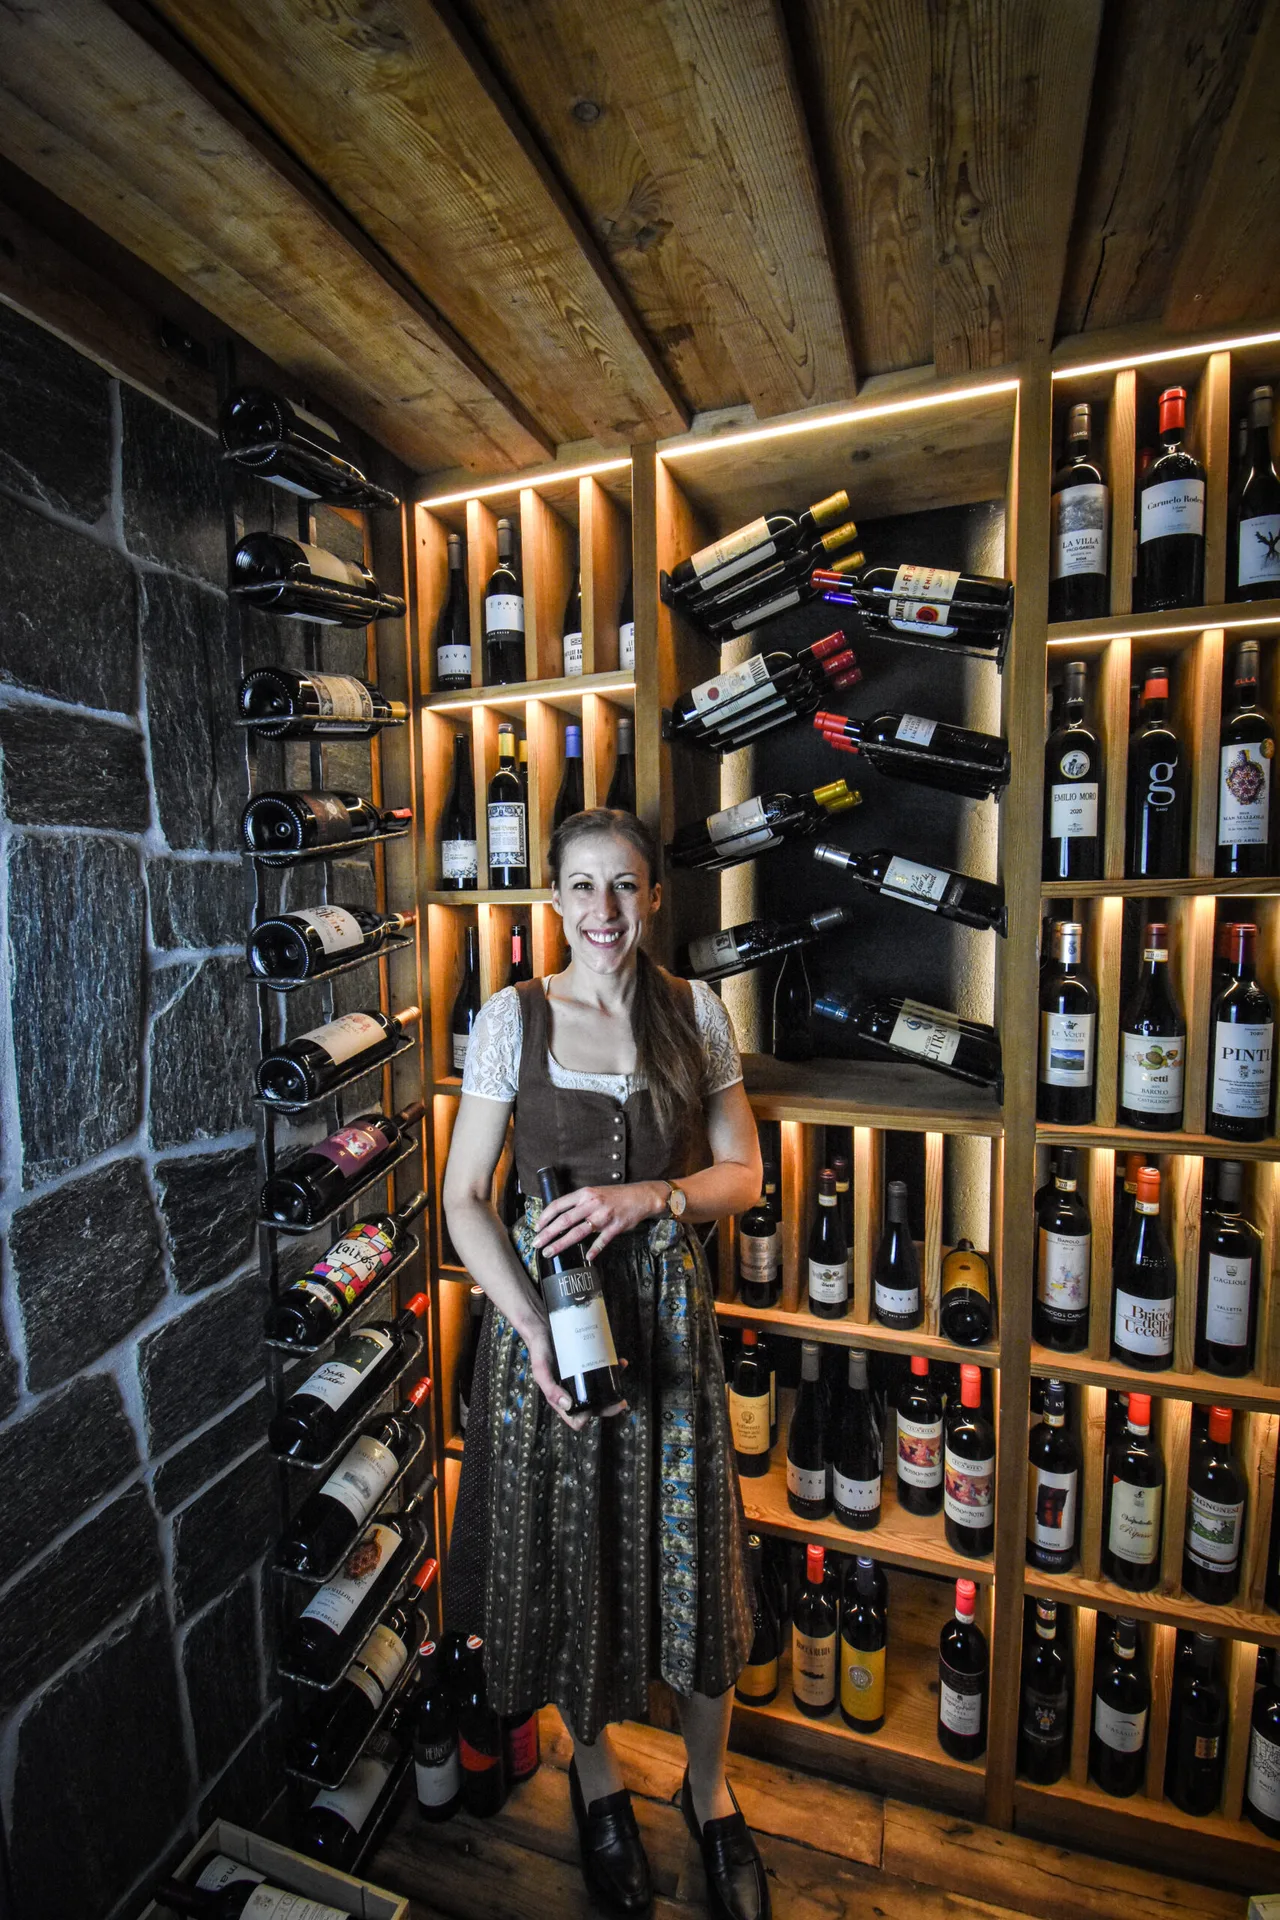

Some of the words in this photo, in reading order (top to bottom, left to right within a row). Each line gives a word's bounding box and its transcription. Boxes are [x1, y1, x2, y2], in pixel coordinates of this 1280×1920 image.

[1147, 496, 1181, 510] Carmelo
[1062, 541, 1073, 549] LA
[1075, 537, 1099, 545] VILLA
[1147, 754, 1179, 806] g
[1054, 792, 1077, 802] EMILIO
[1079, 792, 1097, 801] MORO
[558, 1272, 595, 1297] HEINRICH
[1213, 1276, 1247, 1286] GAGLIOLE
[1216, 1304, 1242, 1312] VALLETTA
